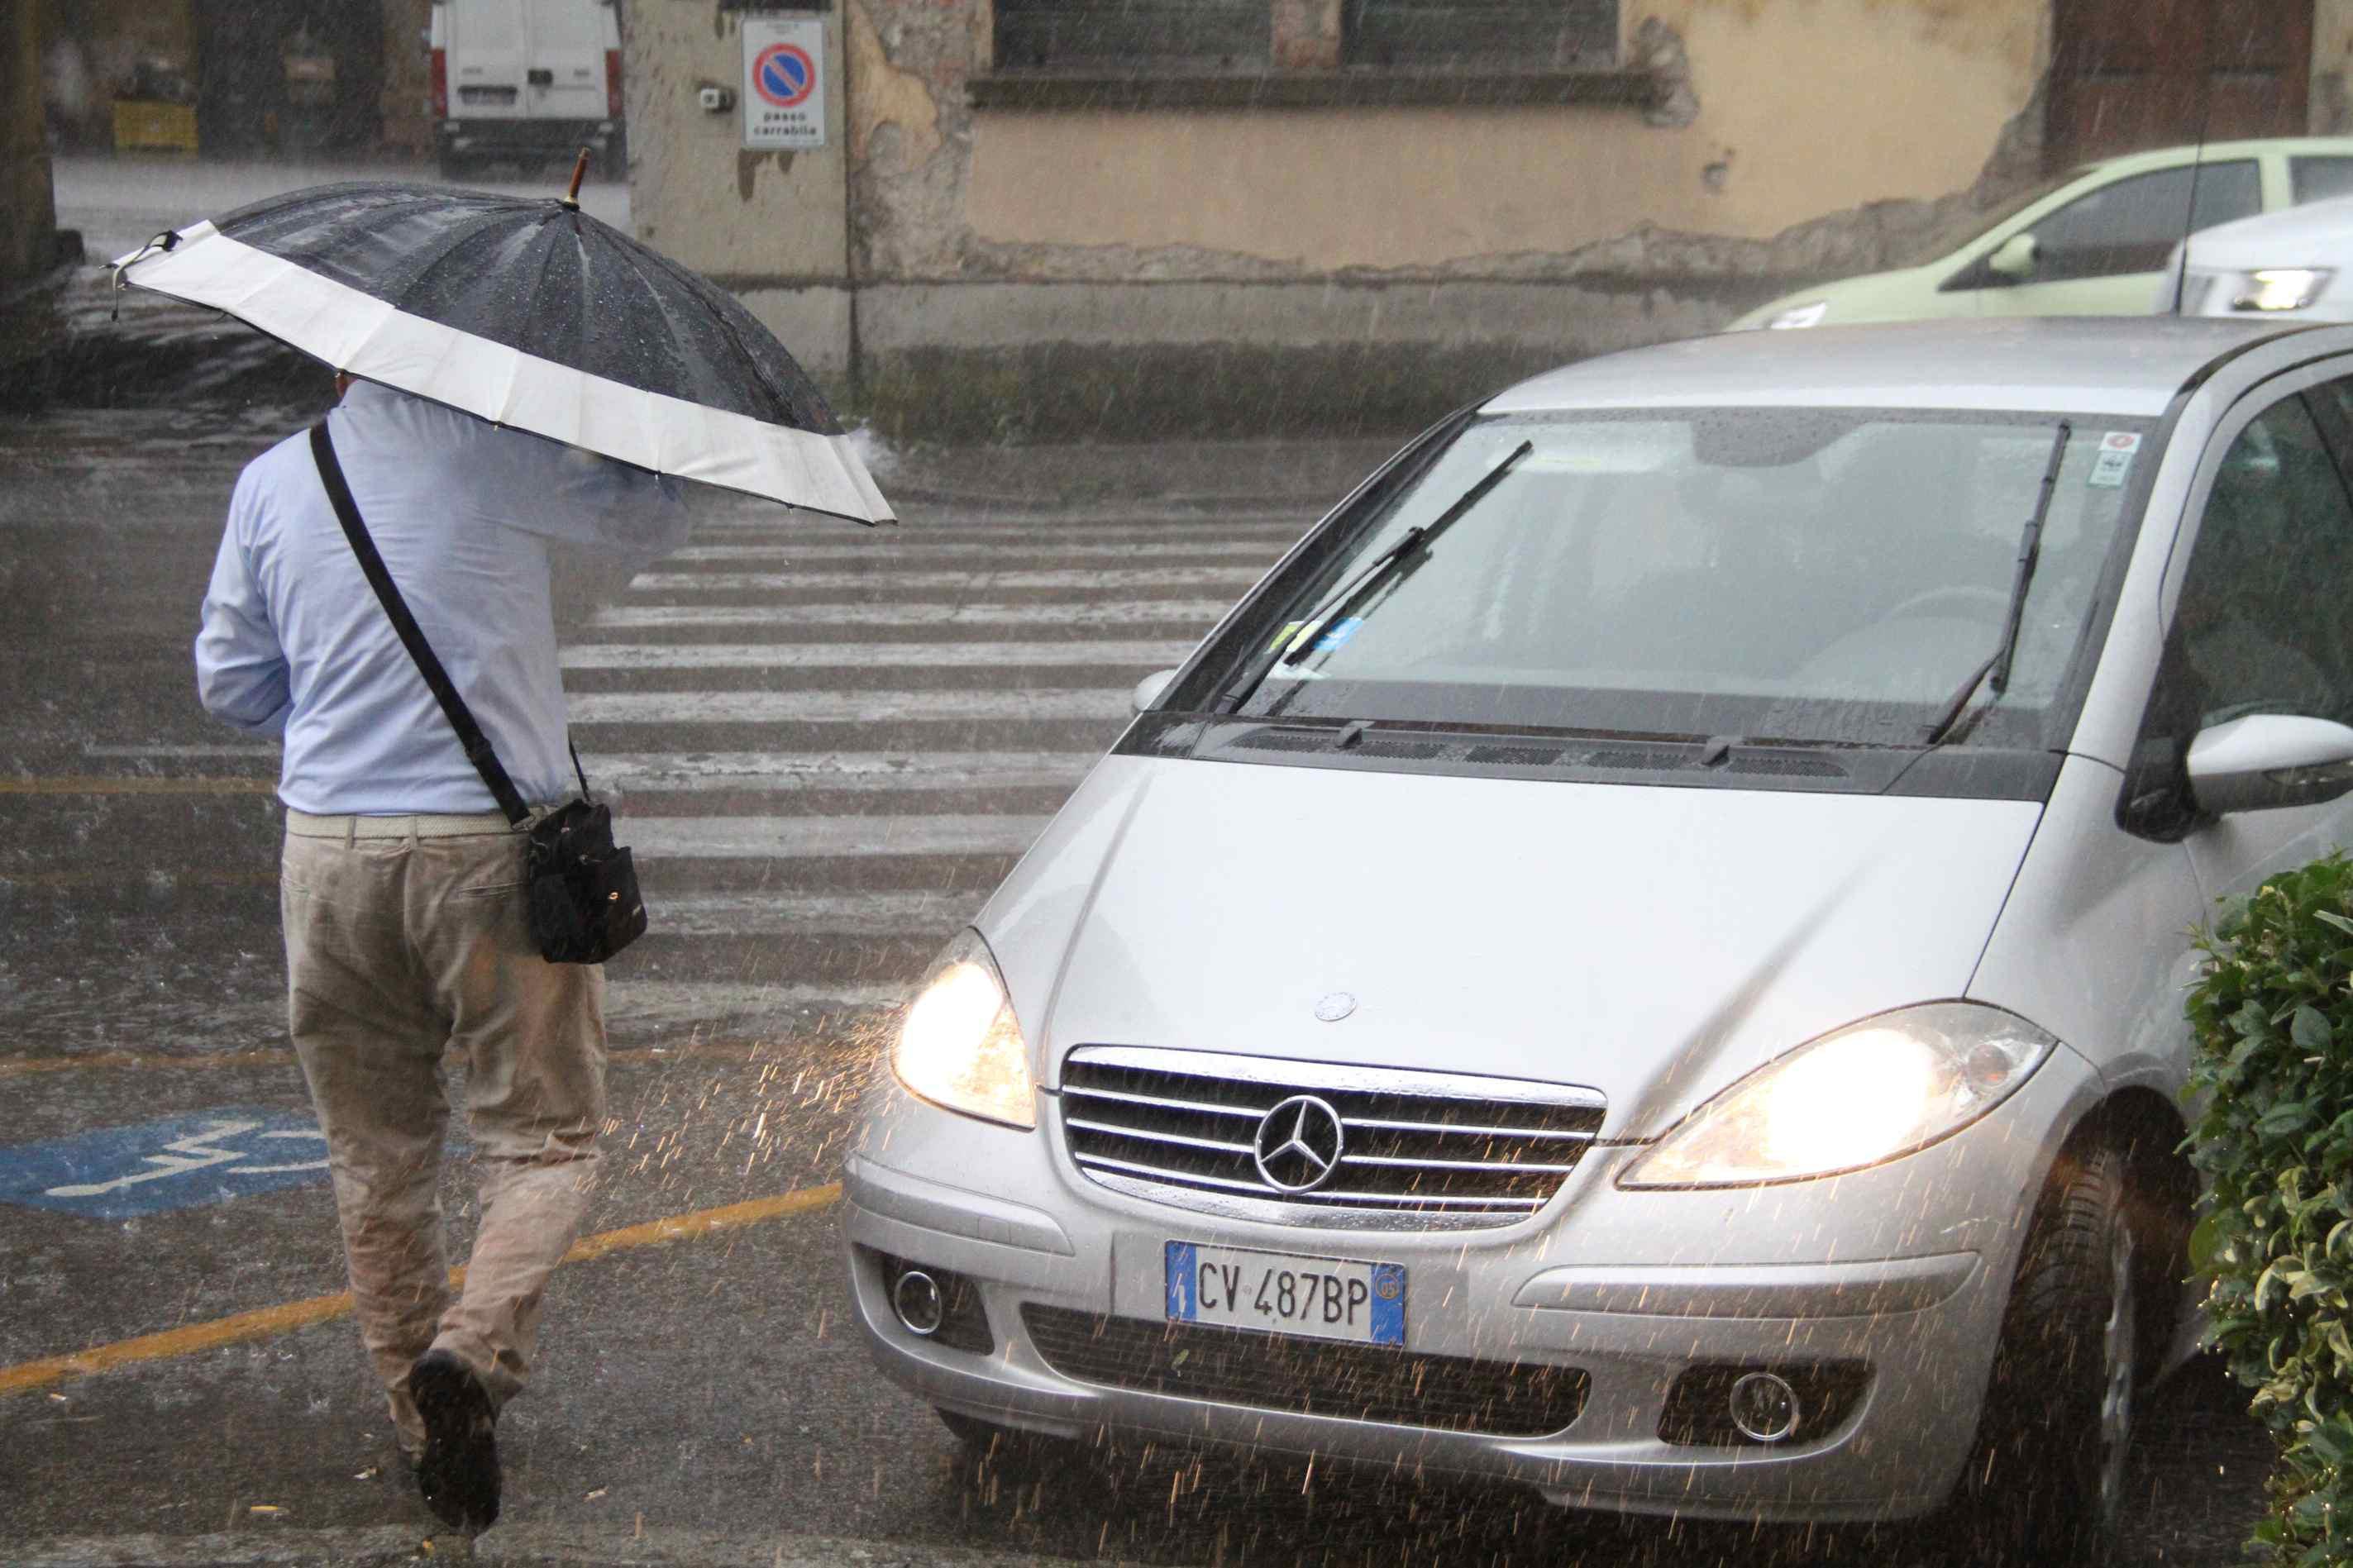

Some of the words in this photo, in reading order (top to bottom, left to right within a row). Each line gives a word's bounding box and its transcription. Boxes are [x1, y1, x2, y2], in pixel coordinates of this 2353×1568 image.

[763, 112, 806, 122] passo
[753, 125, 817, 136] carrabile
[1198, 1261, 1239, 1312] CV
[1253, 1268, 1368, 1324] 487BP
